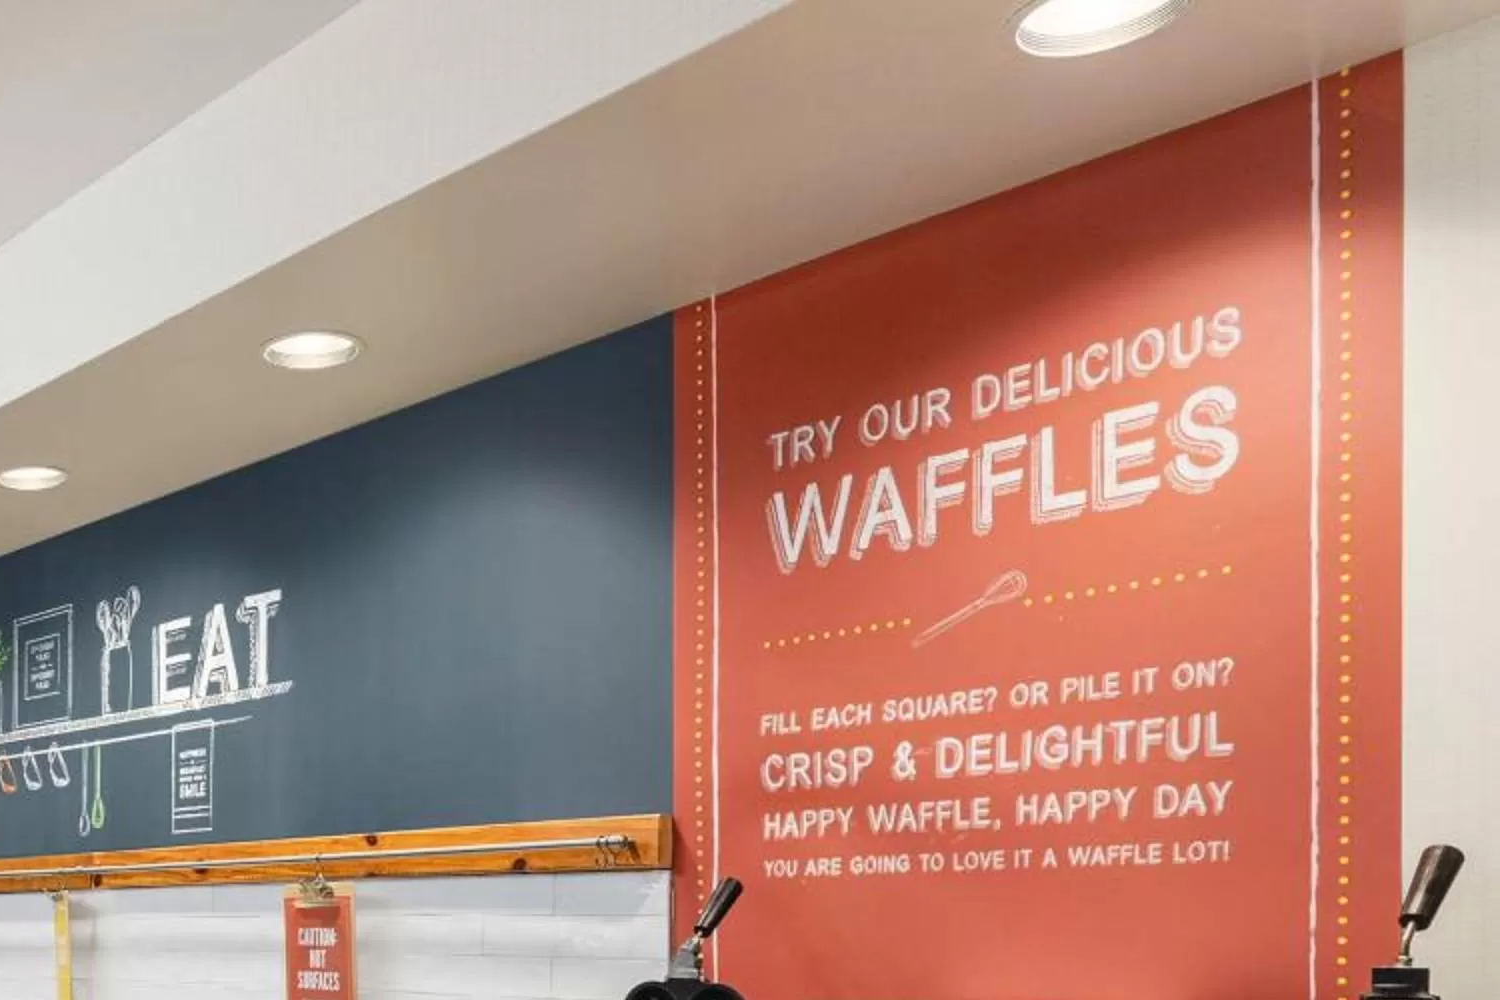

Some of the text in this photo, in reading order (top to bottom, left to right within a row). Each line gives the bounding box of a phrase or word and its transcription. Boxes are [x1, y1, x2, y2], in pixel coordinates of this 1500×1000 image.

[768, 306, 1242, 471] TRY OUR DELICIOUS
[765, 384, 1241, 576] WAFFLES
[151, 588, 283, 705] EAT
[760, 656, 1235, 736] FILL EACH SQUARE? OR PILE IT ON?
[759, 711, 1235, 793] CRISP & DELIGHTFUL
[762, 780, 1234, 841] HAPPY WAFFLE, HAPPY DAY
[763, 840, 1232, 879] YOU ARE GOING TO LOVE IT A WAFFLE LOT!
[296, 971, 341, 992] SURFACES
[309, 949, 327, 969] HOT
